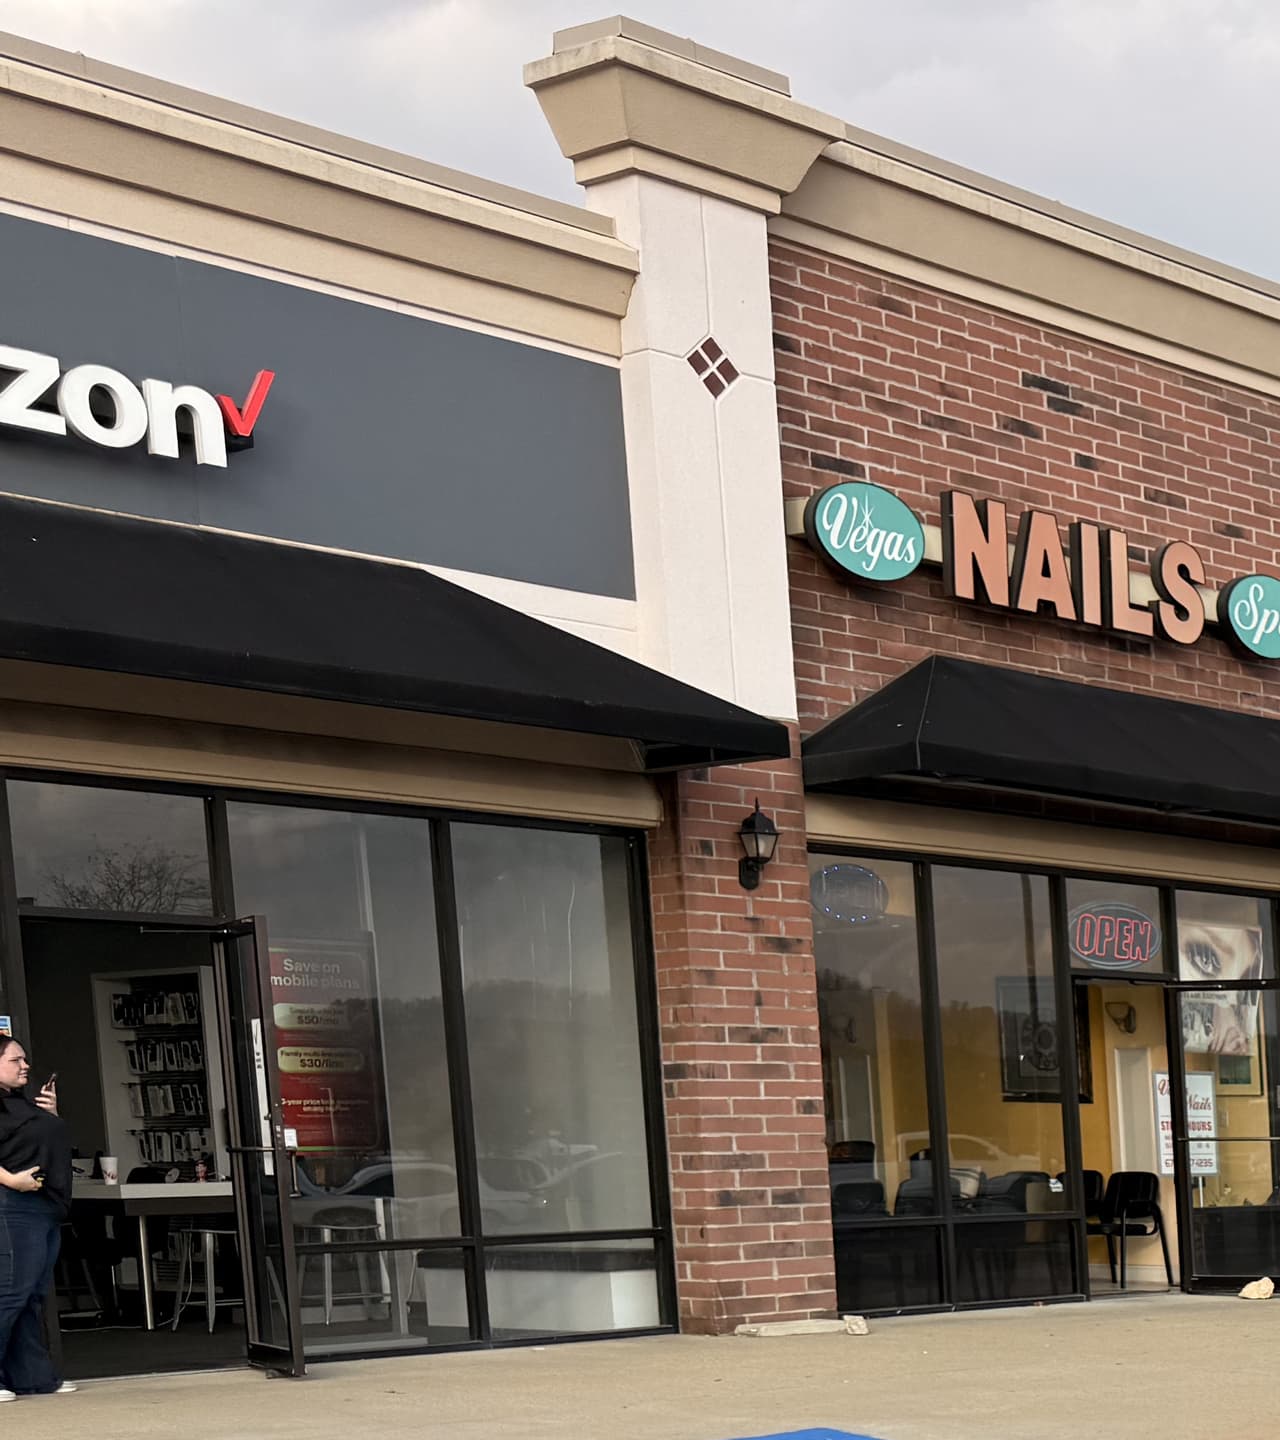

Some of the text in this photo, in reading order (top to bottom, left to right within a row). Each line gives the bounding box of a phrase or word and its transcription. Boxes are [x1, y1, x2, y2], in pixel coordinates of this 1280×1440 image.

[822, 492, 918, 572] Vegas
[945, 490, 1205, 645] NAILS
[1076, 913, 1152, 961] OPEN
[270, 974, 319, 986] mobile
[283, 958, 319, 972] Save
